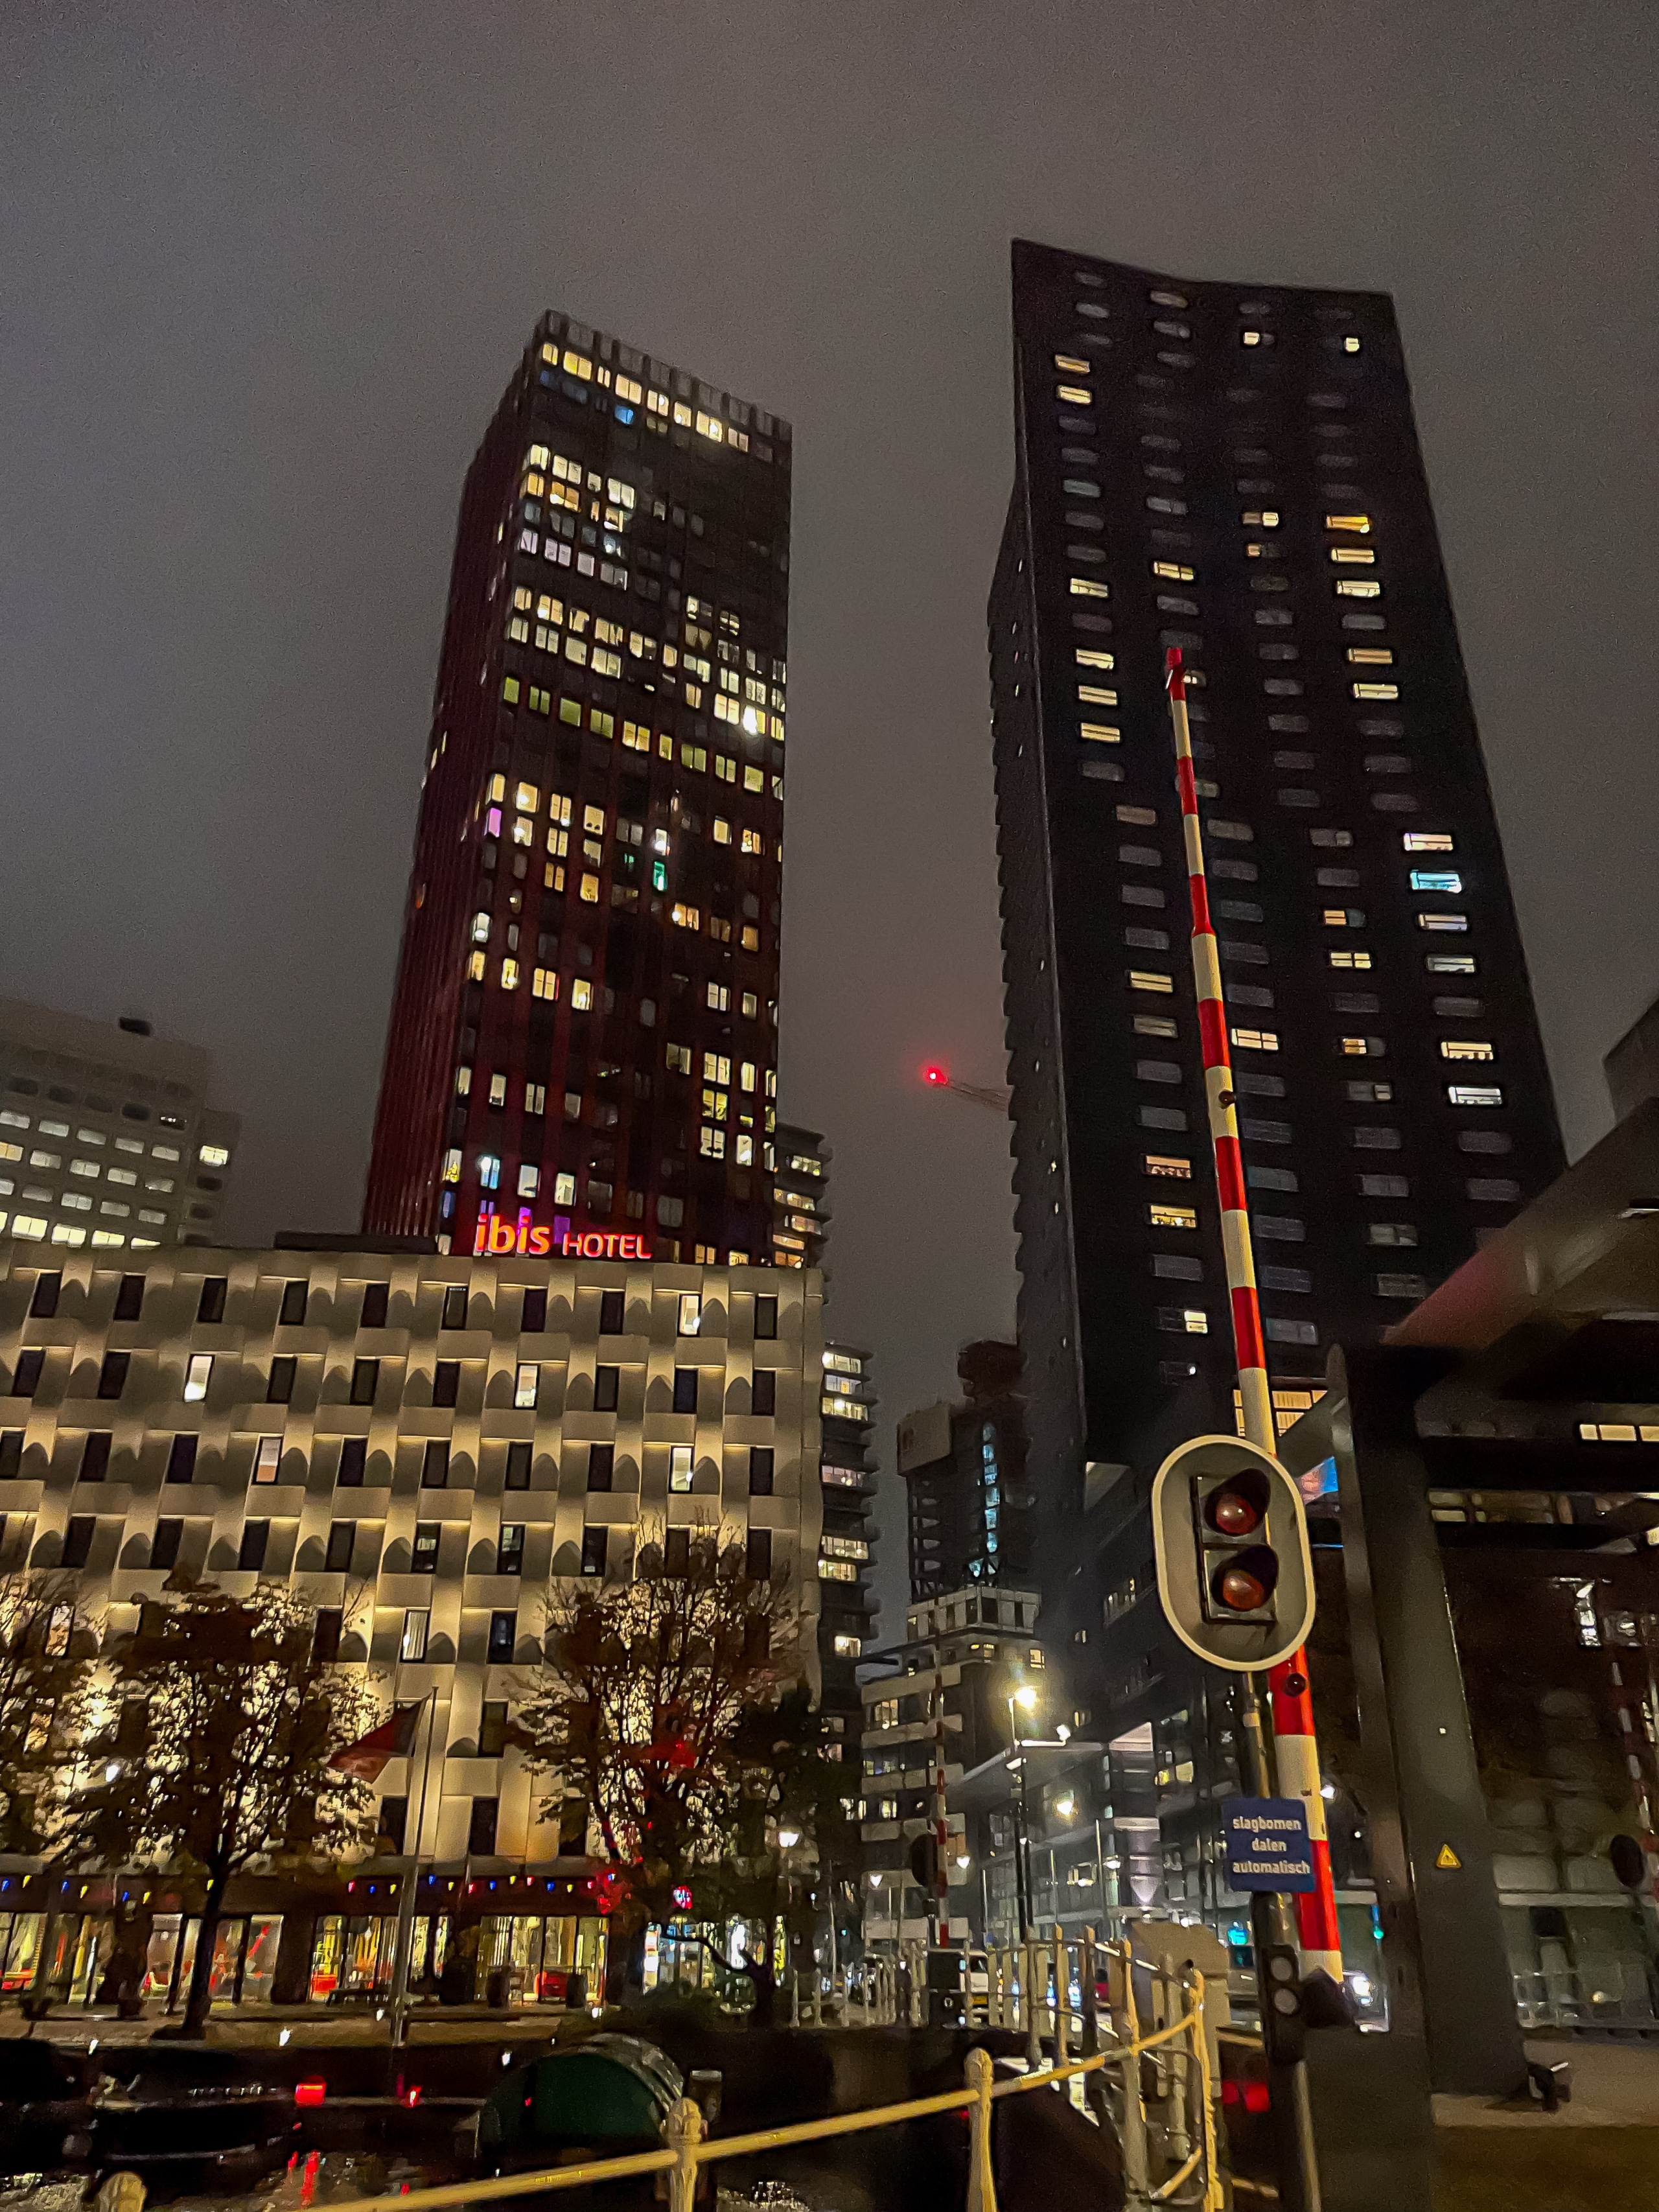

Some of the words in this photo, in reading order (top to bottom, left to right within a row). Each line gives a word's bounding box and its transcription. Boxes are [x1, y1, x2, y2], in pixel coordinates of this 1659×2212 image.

[474, 1213, 550, 1255] ibis
[563, 1232, 652, 1259] HOTEL
[1233, 1815, 1302, 1833] slagbomen
[1252, 1837, 1287, 1852] dalen
[1233, 1859, 1310, 1874] automatisch
